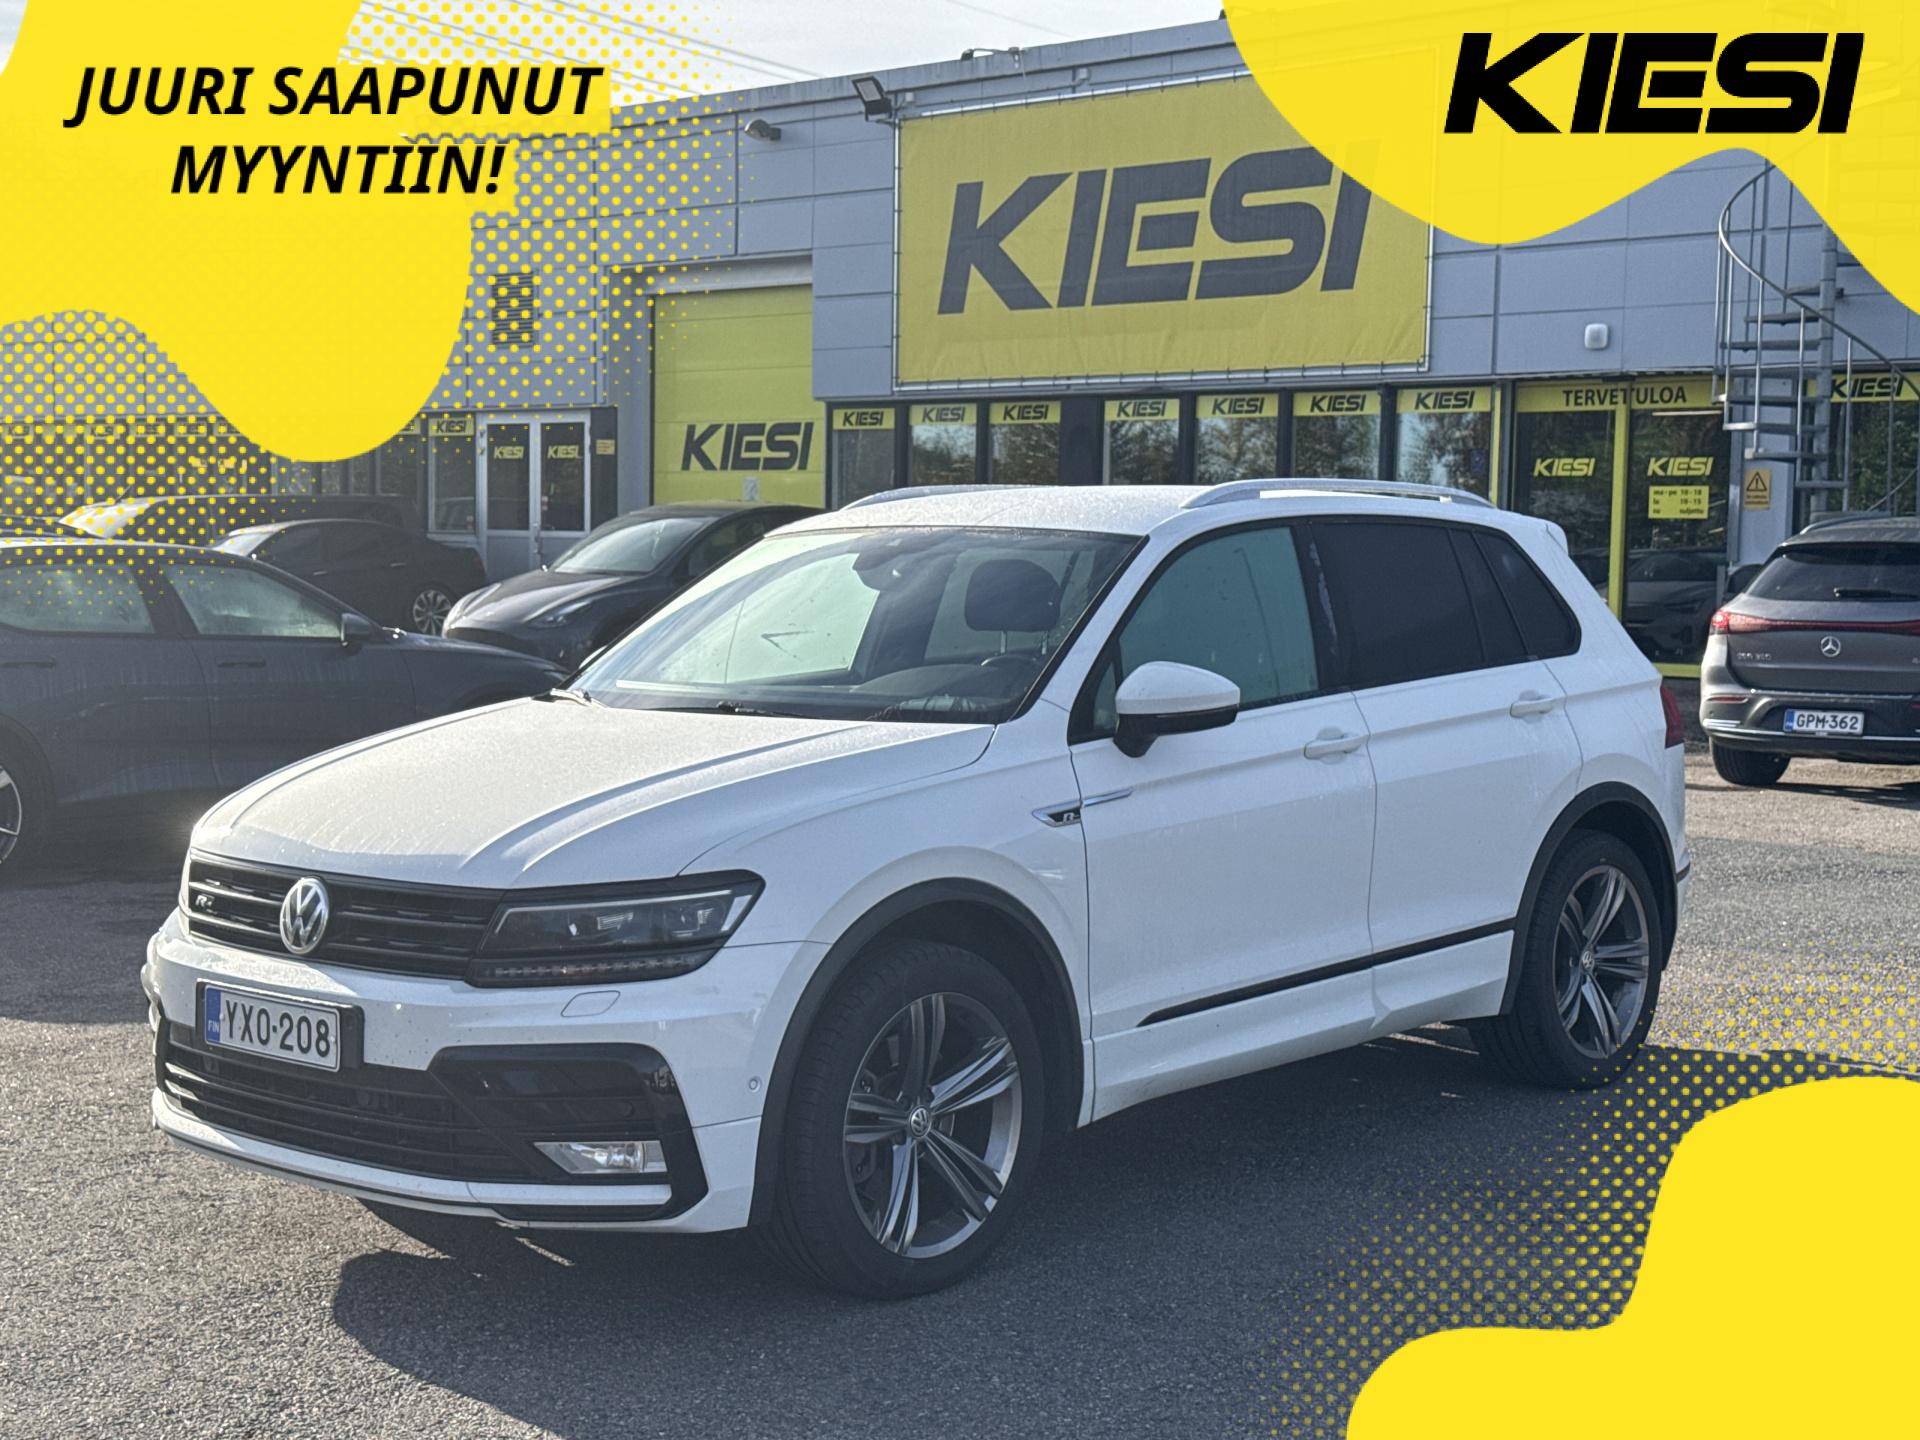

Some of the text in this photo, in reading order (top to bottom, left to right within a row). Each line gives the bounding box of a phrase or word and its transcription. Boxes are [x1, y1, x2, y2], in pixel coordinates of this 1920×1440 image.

[937, 146, 1372, 315] KIESI
[1830, 376, 1904, 398] KIESI
[1310, 394, 1367, 412] KIESI
[1414, 390, 1475, 409] KIESI
[1562, 386, 1687, 407] TERVETULOA
[922, 405, 965, 423] KIESI
[1003, 404, 1048, 421] KIESI
[1117, 400, 1166, 417] KIESI
[1212, 397, 1264, 415] KIESI
[842, 411, 884, 427] KIESI
[494, 446, 524, 459] KIESI
[681, 422, 814, 471] KIESI
[1533, 457, 1595, 477] KIESI
[1647, 456, 1714, 476] KIESI
[1796, 713, 1859, 730] GPM-362
[208, 999, 330, 1057] FIN YXO-208
